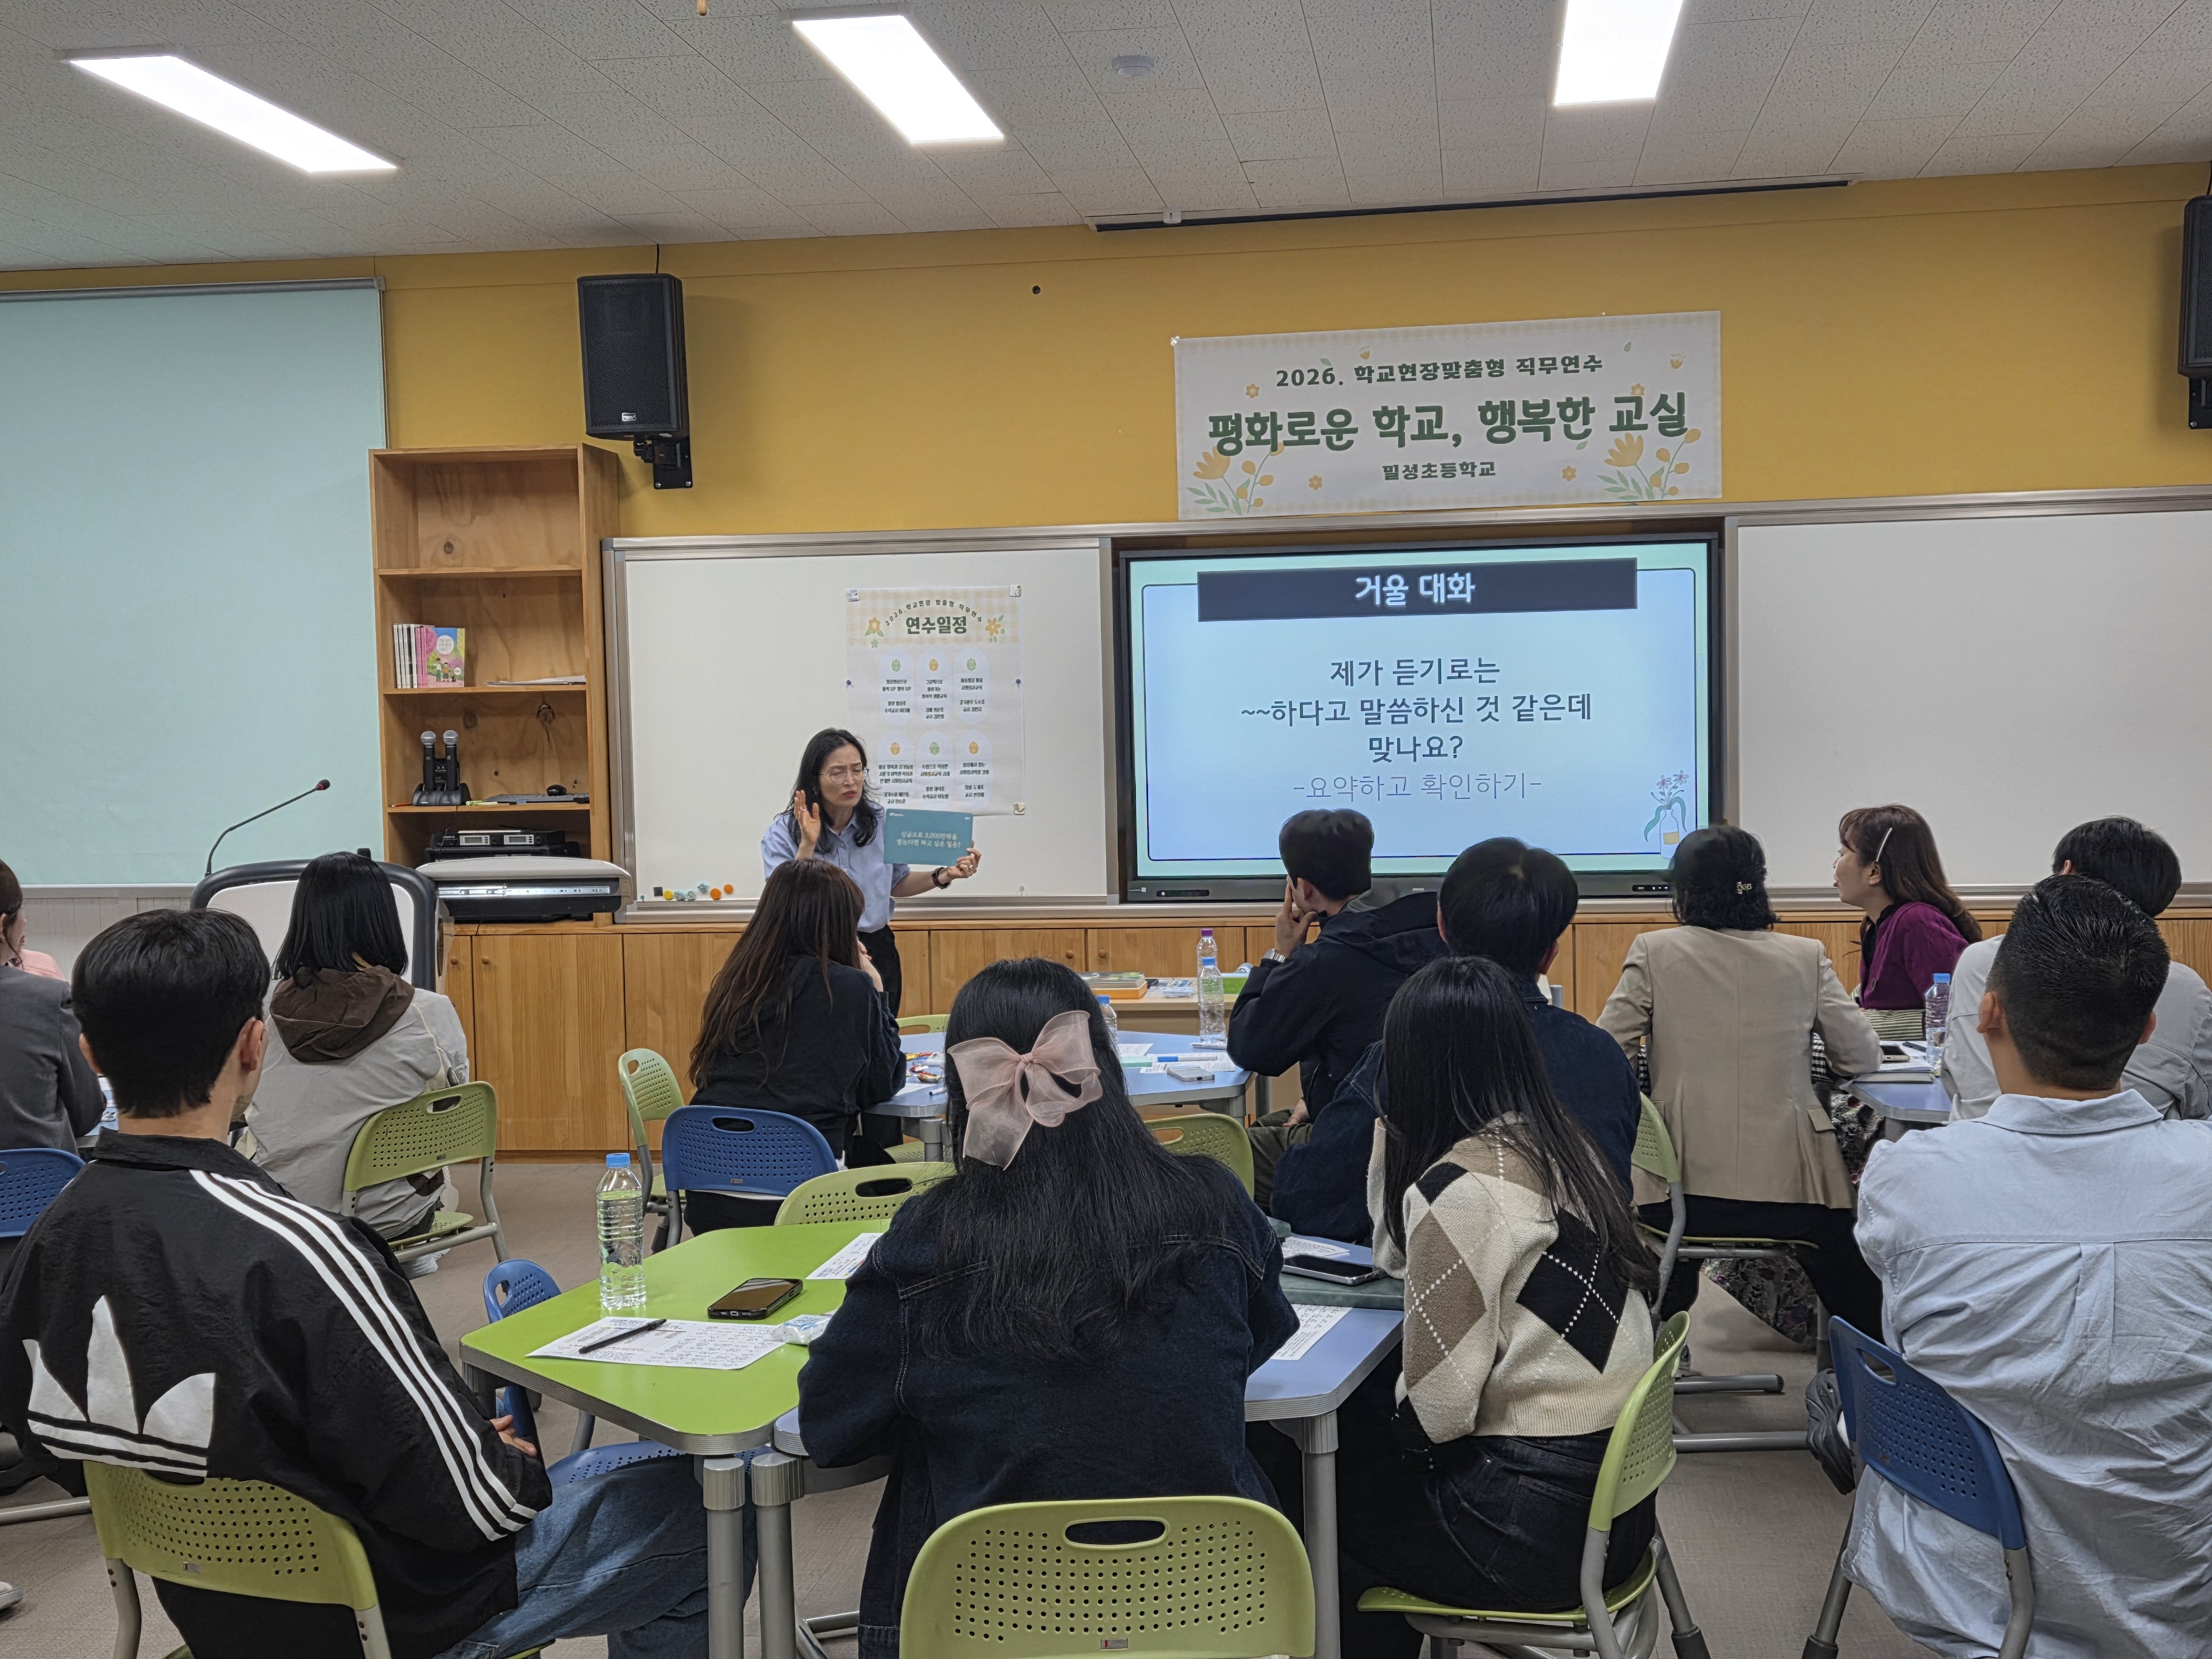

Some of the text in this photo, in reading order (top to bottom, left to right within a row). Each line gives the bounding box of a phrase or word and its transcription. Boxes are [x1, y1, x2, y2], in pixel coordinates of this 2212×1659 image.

[1277, 355, 1602, 386] 2026. 학교현장맞춤형 직무연수
[1209, 393, 1687, 456] 평화로운 학교, 행복한 교실
[1356, 573, 1475, 606] 거울 대화
[906, 616, 967, 634] 연수일정
[1331, 658, 1500, 686] 제가 듣기로는
[1361, 697, 1463, 725] 말씀하신
[1477, 696, 1499, 722] 것
[1512, 694, 1590, 721] 같은데
[1370, 736, 1462, 763] 맞나요?
[1294, 773, 1541, 801] -요약하고 확인하기-
